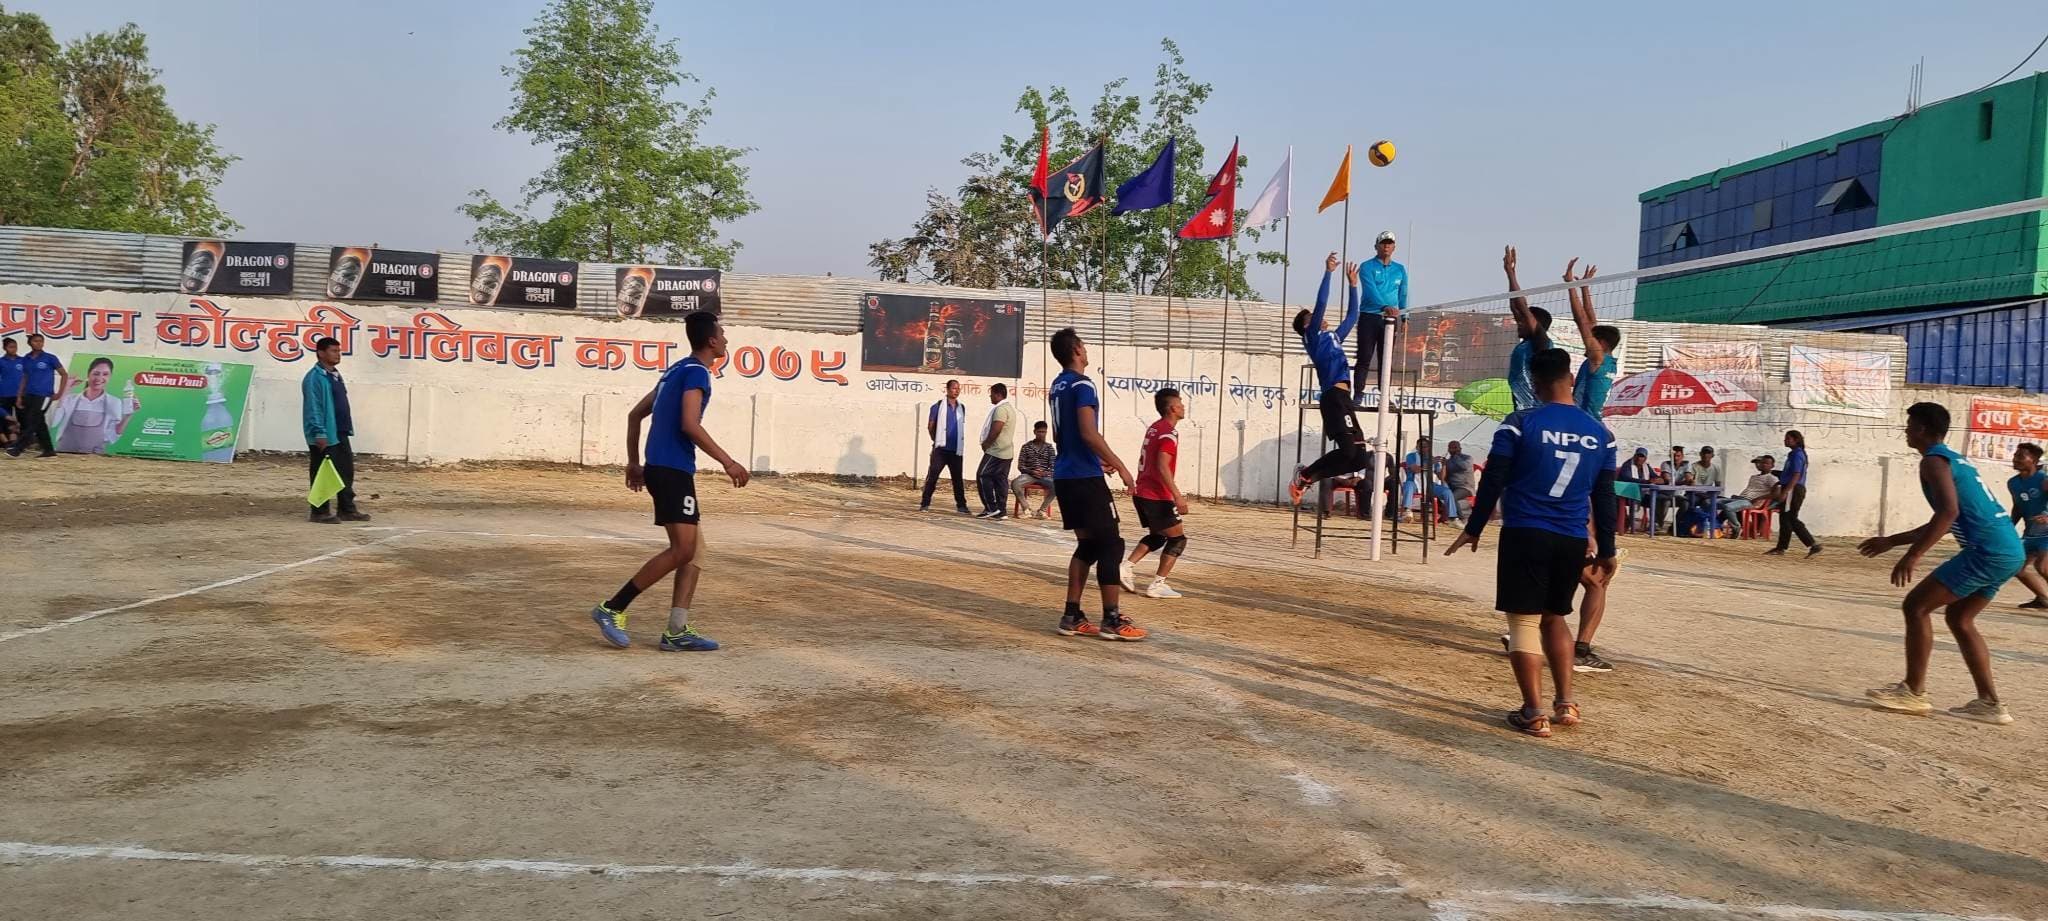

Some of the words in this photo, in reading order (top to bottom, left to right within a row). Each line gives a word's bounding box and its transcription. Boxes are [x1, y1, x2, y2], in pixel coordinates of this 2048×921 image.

[226, 255, 272, 267] DRAGON
[372, 262, 417, 275] DRAGON
[512, 270, 558, 283] DRAGON
[657, 280, 701, 291] DRAGON
[0, 302, 141, 343] प्रथम
[156, 299, 360, 362] कोल्हवी
[368, 312, 562, 369] भलिबल
[575, 336, 677, 372] कप
[140, 373, 177, 386] Nimbu
[179, 376, 205, 387] Pani
[1660, 388, 1695, 400] HD
[1344, 415, 1353, 428] 8
[1977, 411, 2013, 430] तृषा
[1541, 430, 1598, 450] NPC
[1549, 450, 1580, 498] 7
[2020, 492, 2030, 502] 9
[683, 496, 695, 516] 9
